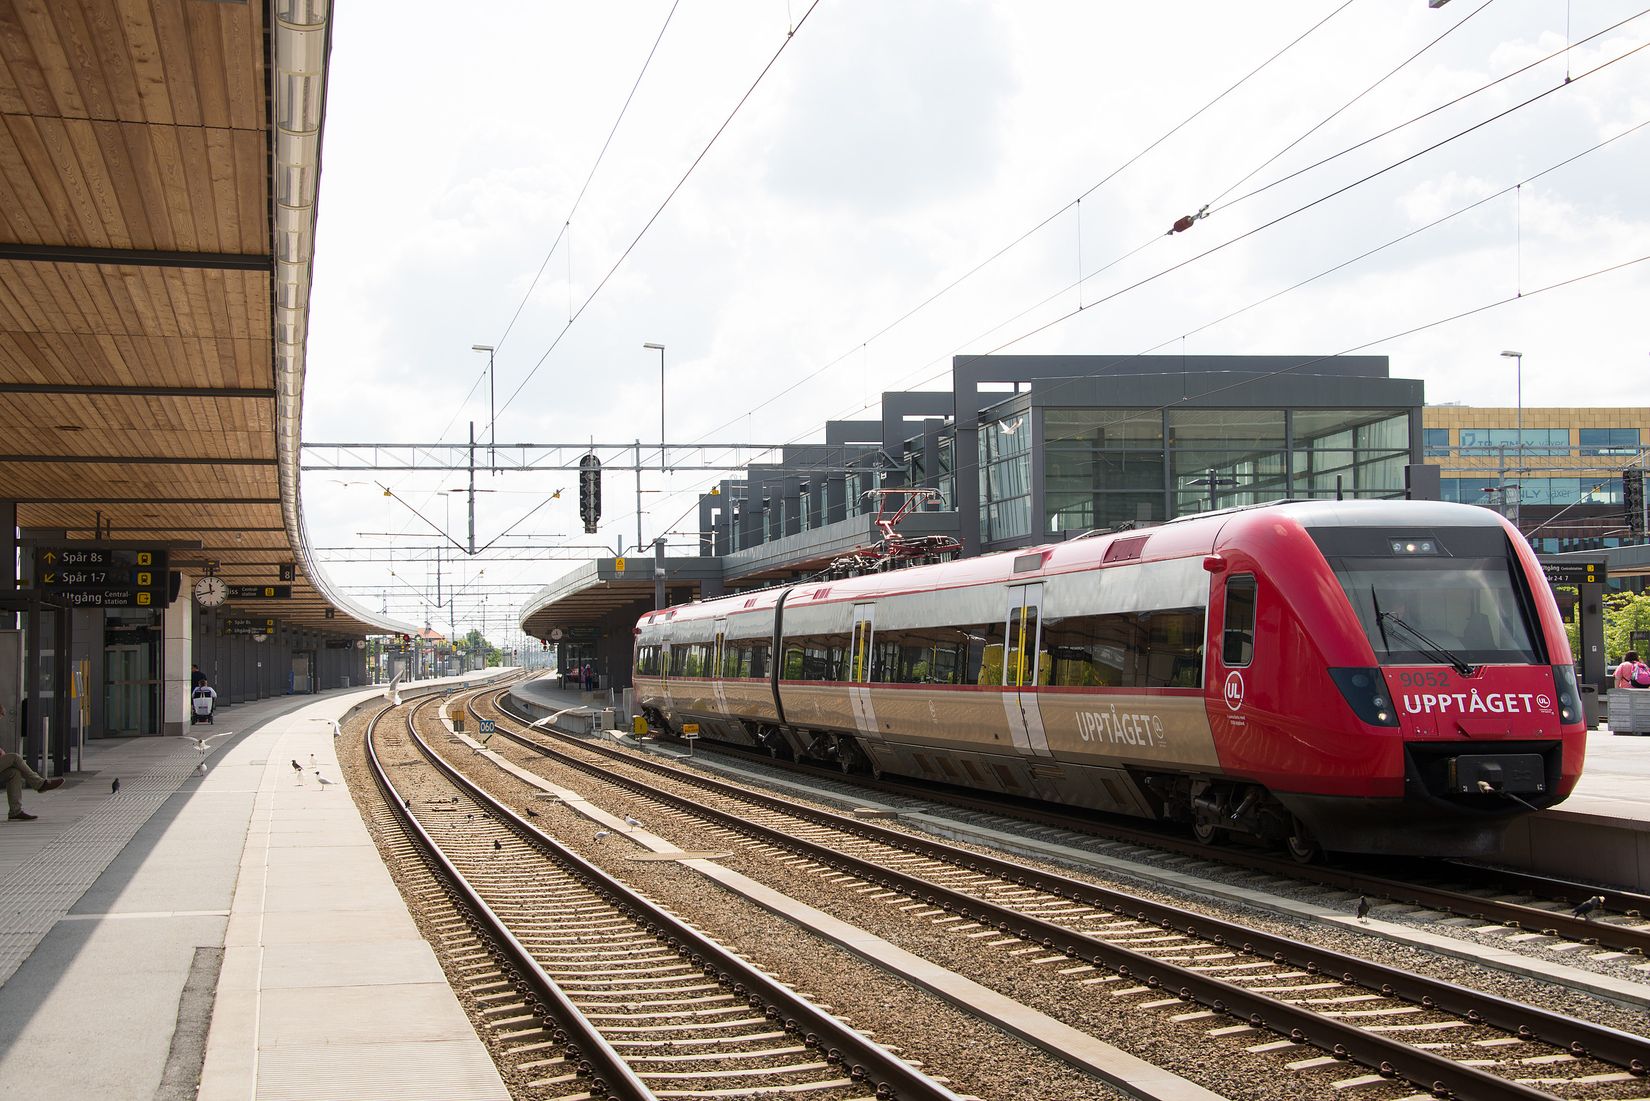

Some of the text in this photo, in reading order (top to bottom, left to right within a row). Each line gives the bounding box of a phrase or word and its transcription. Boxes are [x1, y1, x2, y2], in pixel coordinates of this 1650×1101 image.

[63, 552, 103, 564] Spår 8s
[62, 572, 106, 584] Spår 1-7
[284, 571, 291, 579] 8
[1400, 672, 1449, 687] 9052
[1227, 682, 1241, 699] UL
[1403, 688, 1533, 714] UPPTÅGET
[480, 722, 495, 732] 060
[1075, 703, 1154, 747] UPPTÅGET
